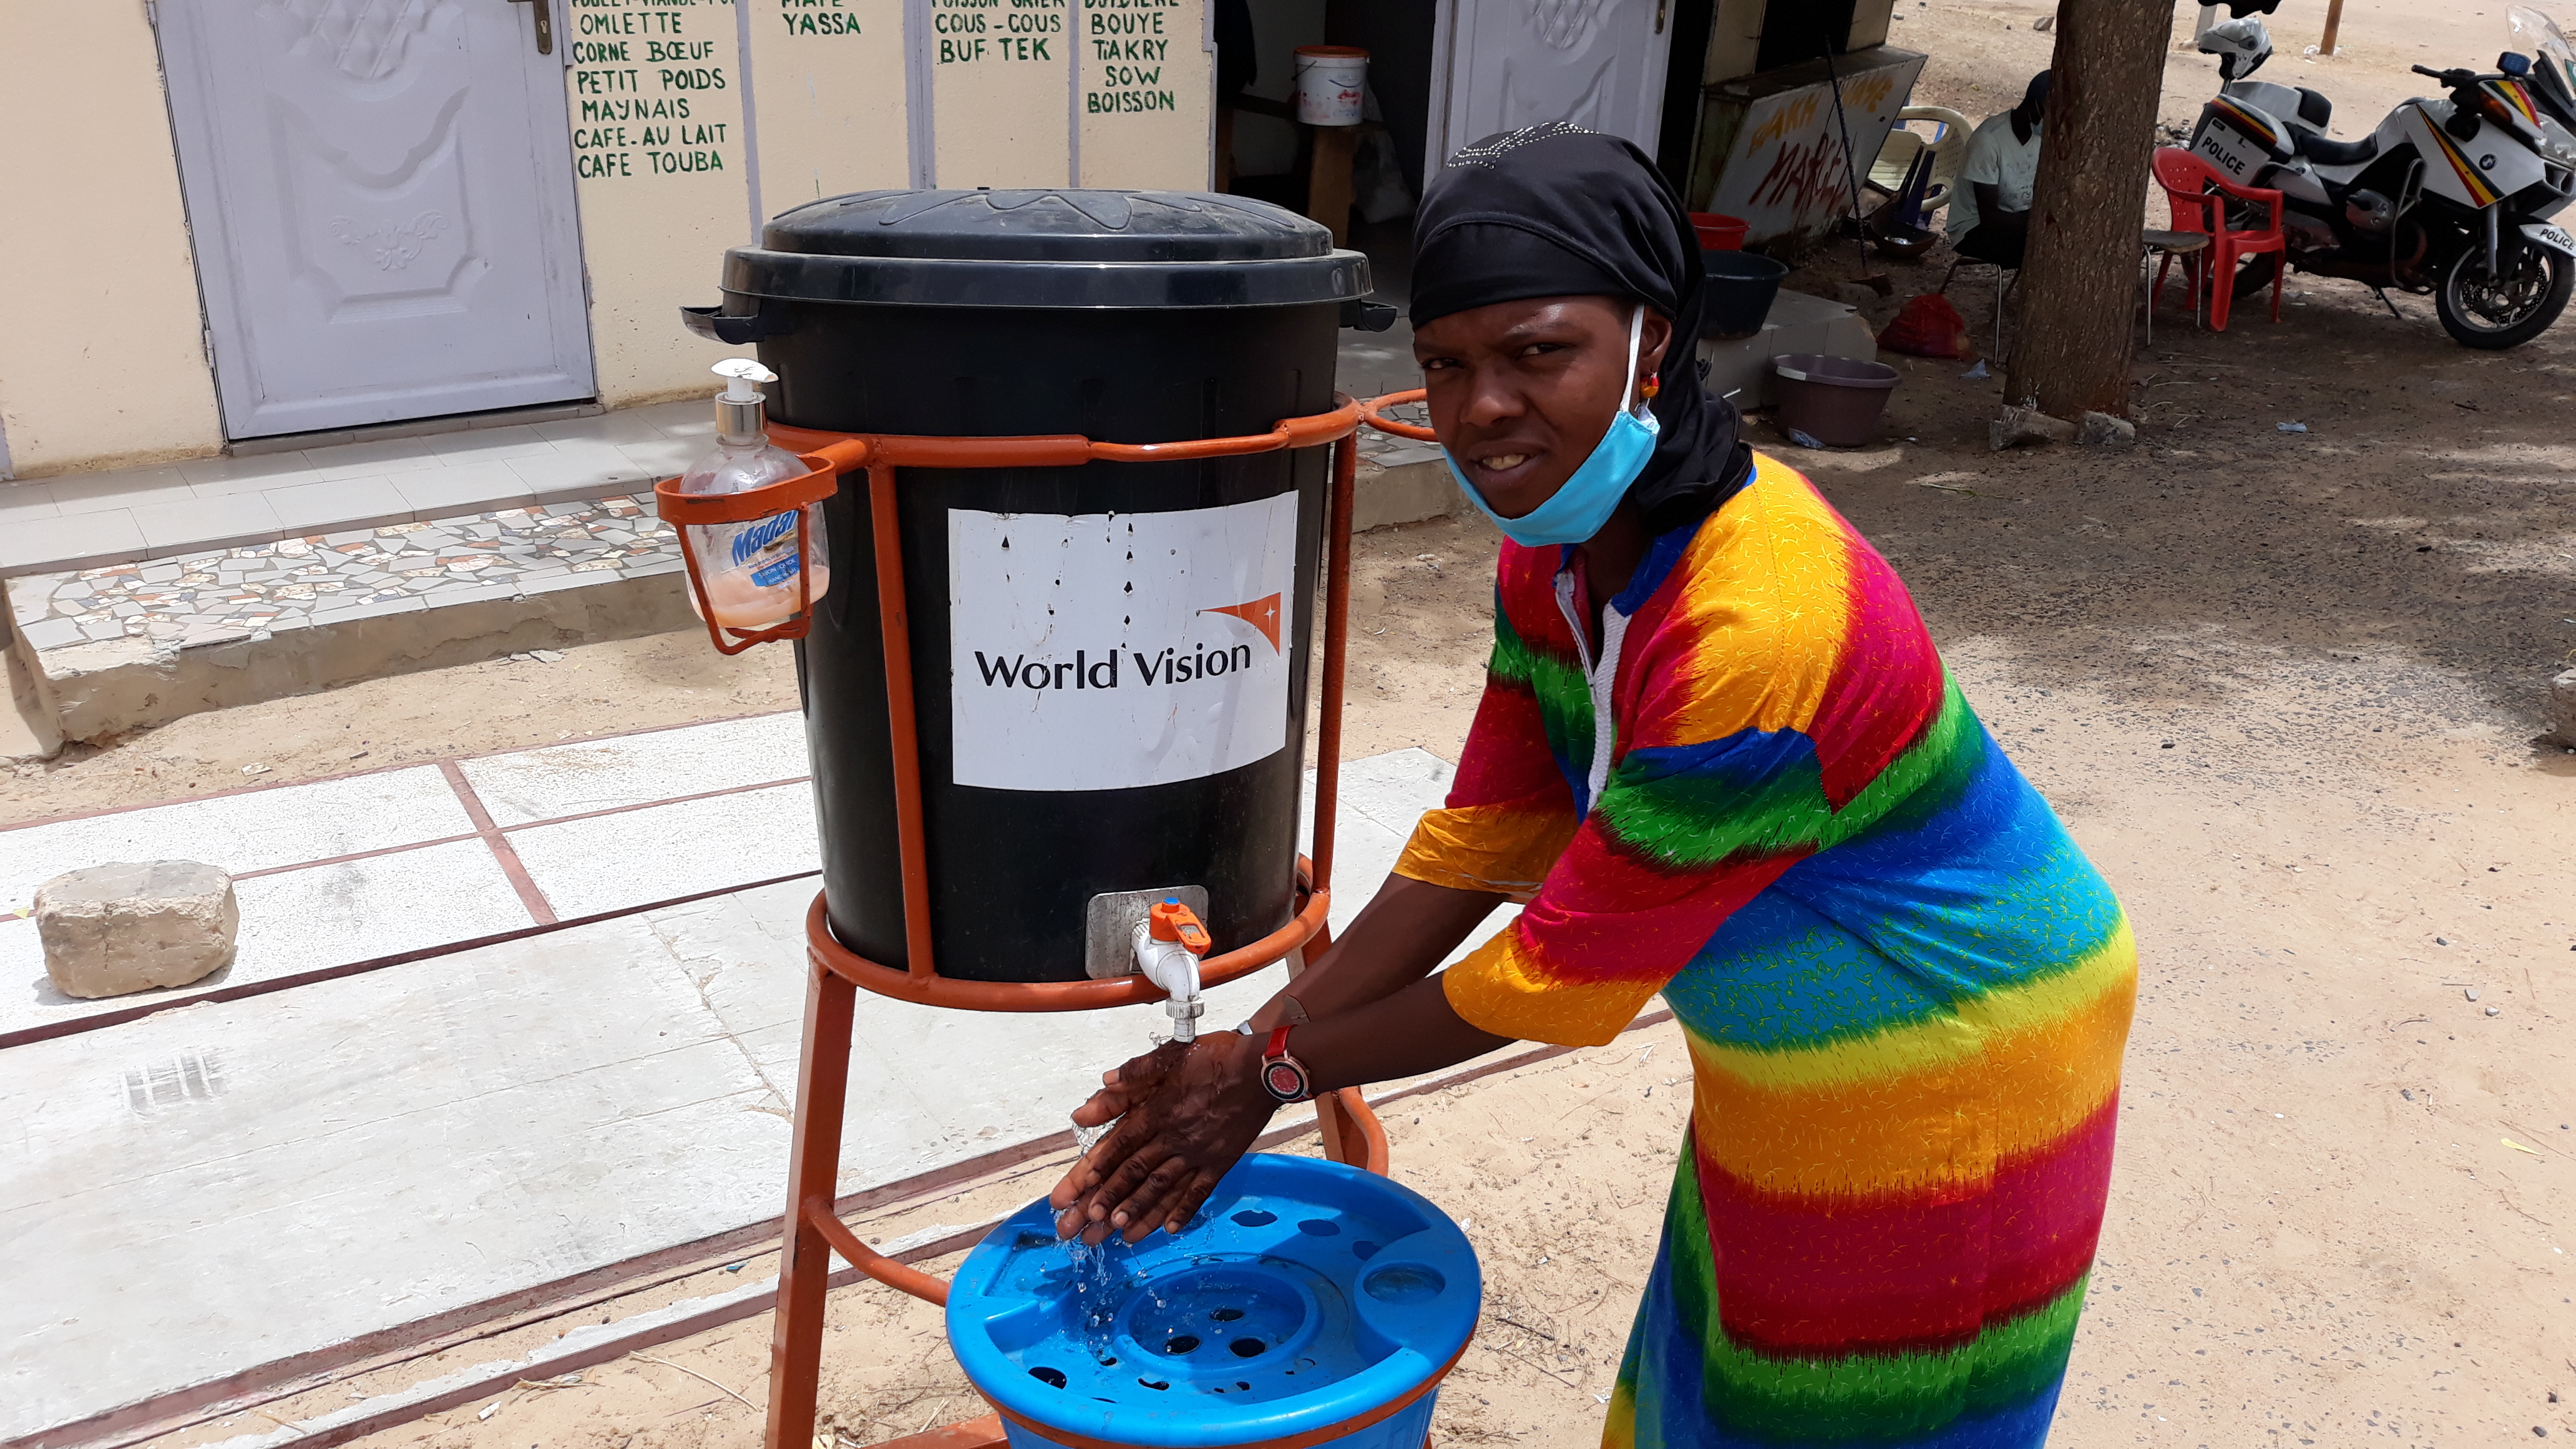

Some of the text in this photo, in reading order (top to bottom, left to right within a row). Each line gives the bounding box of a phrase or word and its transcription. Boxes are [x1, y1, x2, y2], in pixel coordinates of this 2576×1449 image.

[580, 12, 682, 35] OMLETTE
[782, 12, 861, 35] YASSA
[1091, 12, 1164, 34] BOUYE
[573, 41, 631, 64] CORNE
[998, 37, 1051, 61] TEK
[577, 68, 726, 94] PETIT POIDS
[1105, 65, 1161, 87] SOW
[582, 98, 690, 122] MAYNAIS
[1088, 90, 1174, 113] BOISSON
[681, 124, 726, 145] LAIT
[578, 150, 723, 178] CAFE TOUBA
[2202, 136, 2245, 175] POLICE
[2540, 228, 2574, 250] POLICE
[974, 643, 1251, 690] World Vision
